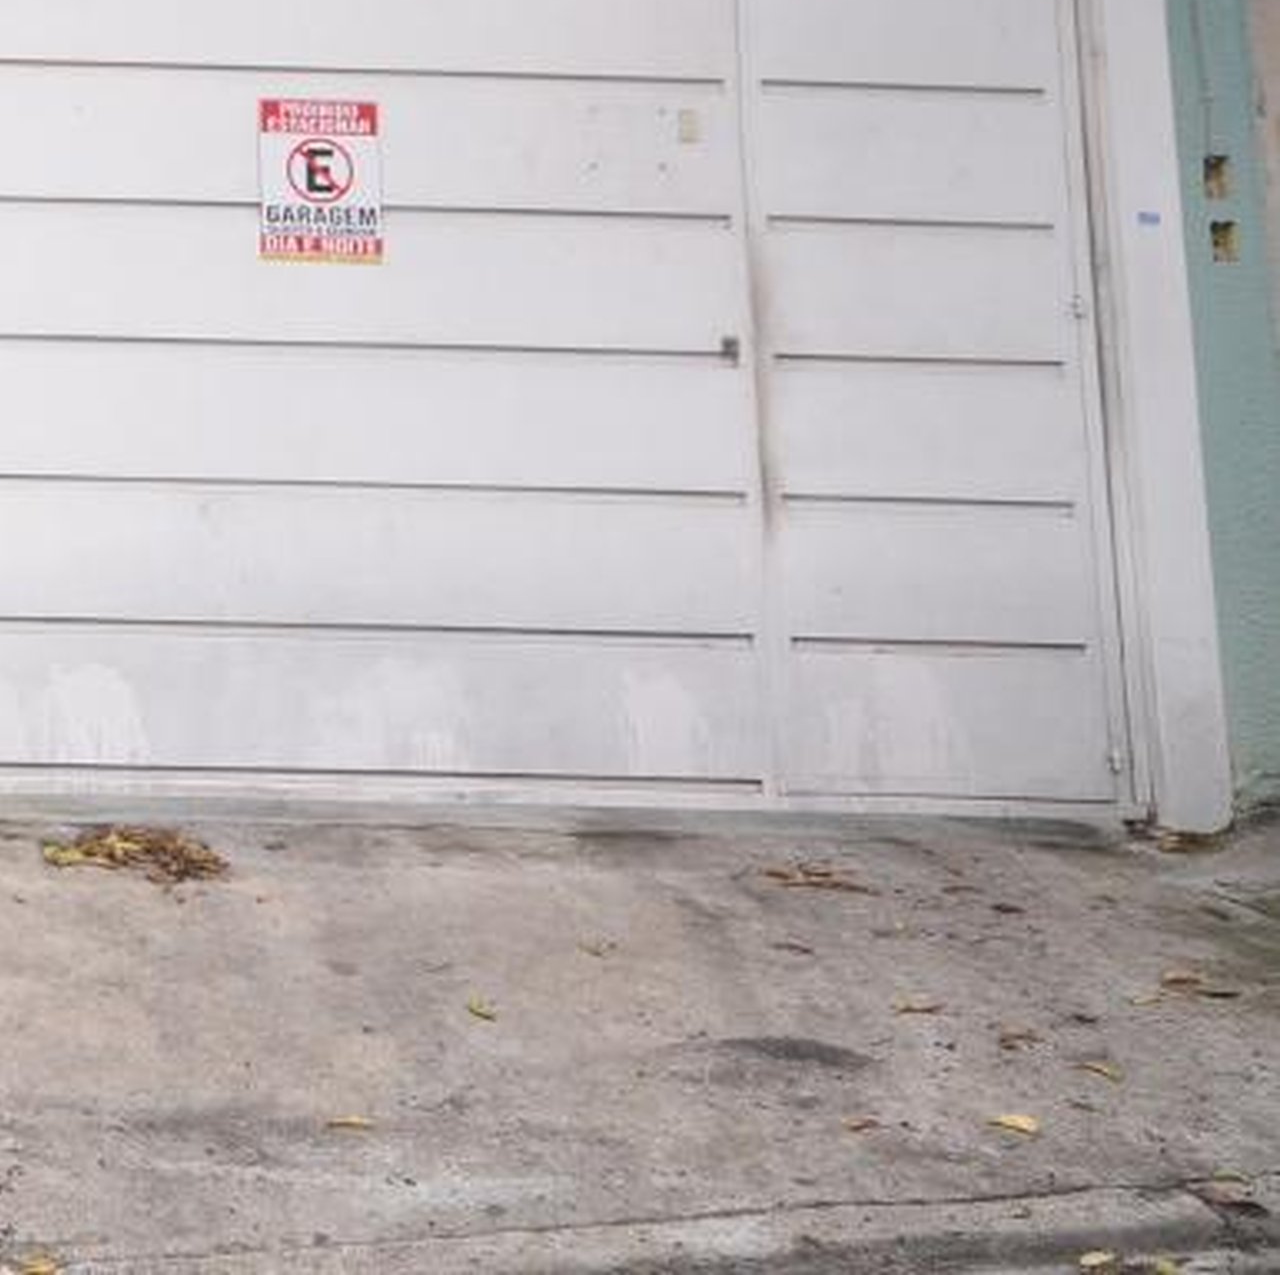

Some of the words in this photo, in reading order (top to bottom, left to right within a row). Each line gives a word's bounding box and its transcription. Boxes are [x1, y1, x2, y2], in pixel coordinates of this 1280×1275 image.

[266, 117, 372, 134] ESTACIONAR
[266, 206, 378, 227] GARAGEM
[265, 235, 299, 253] DIA
[322, 238, 375, 256] NOITE
